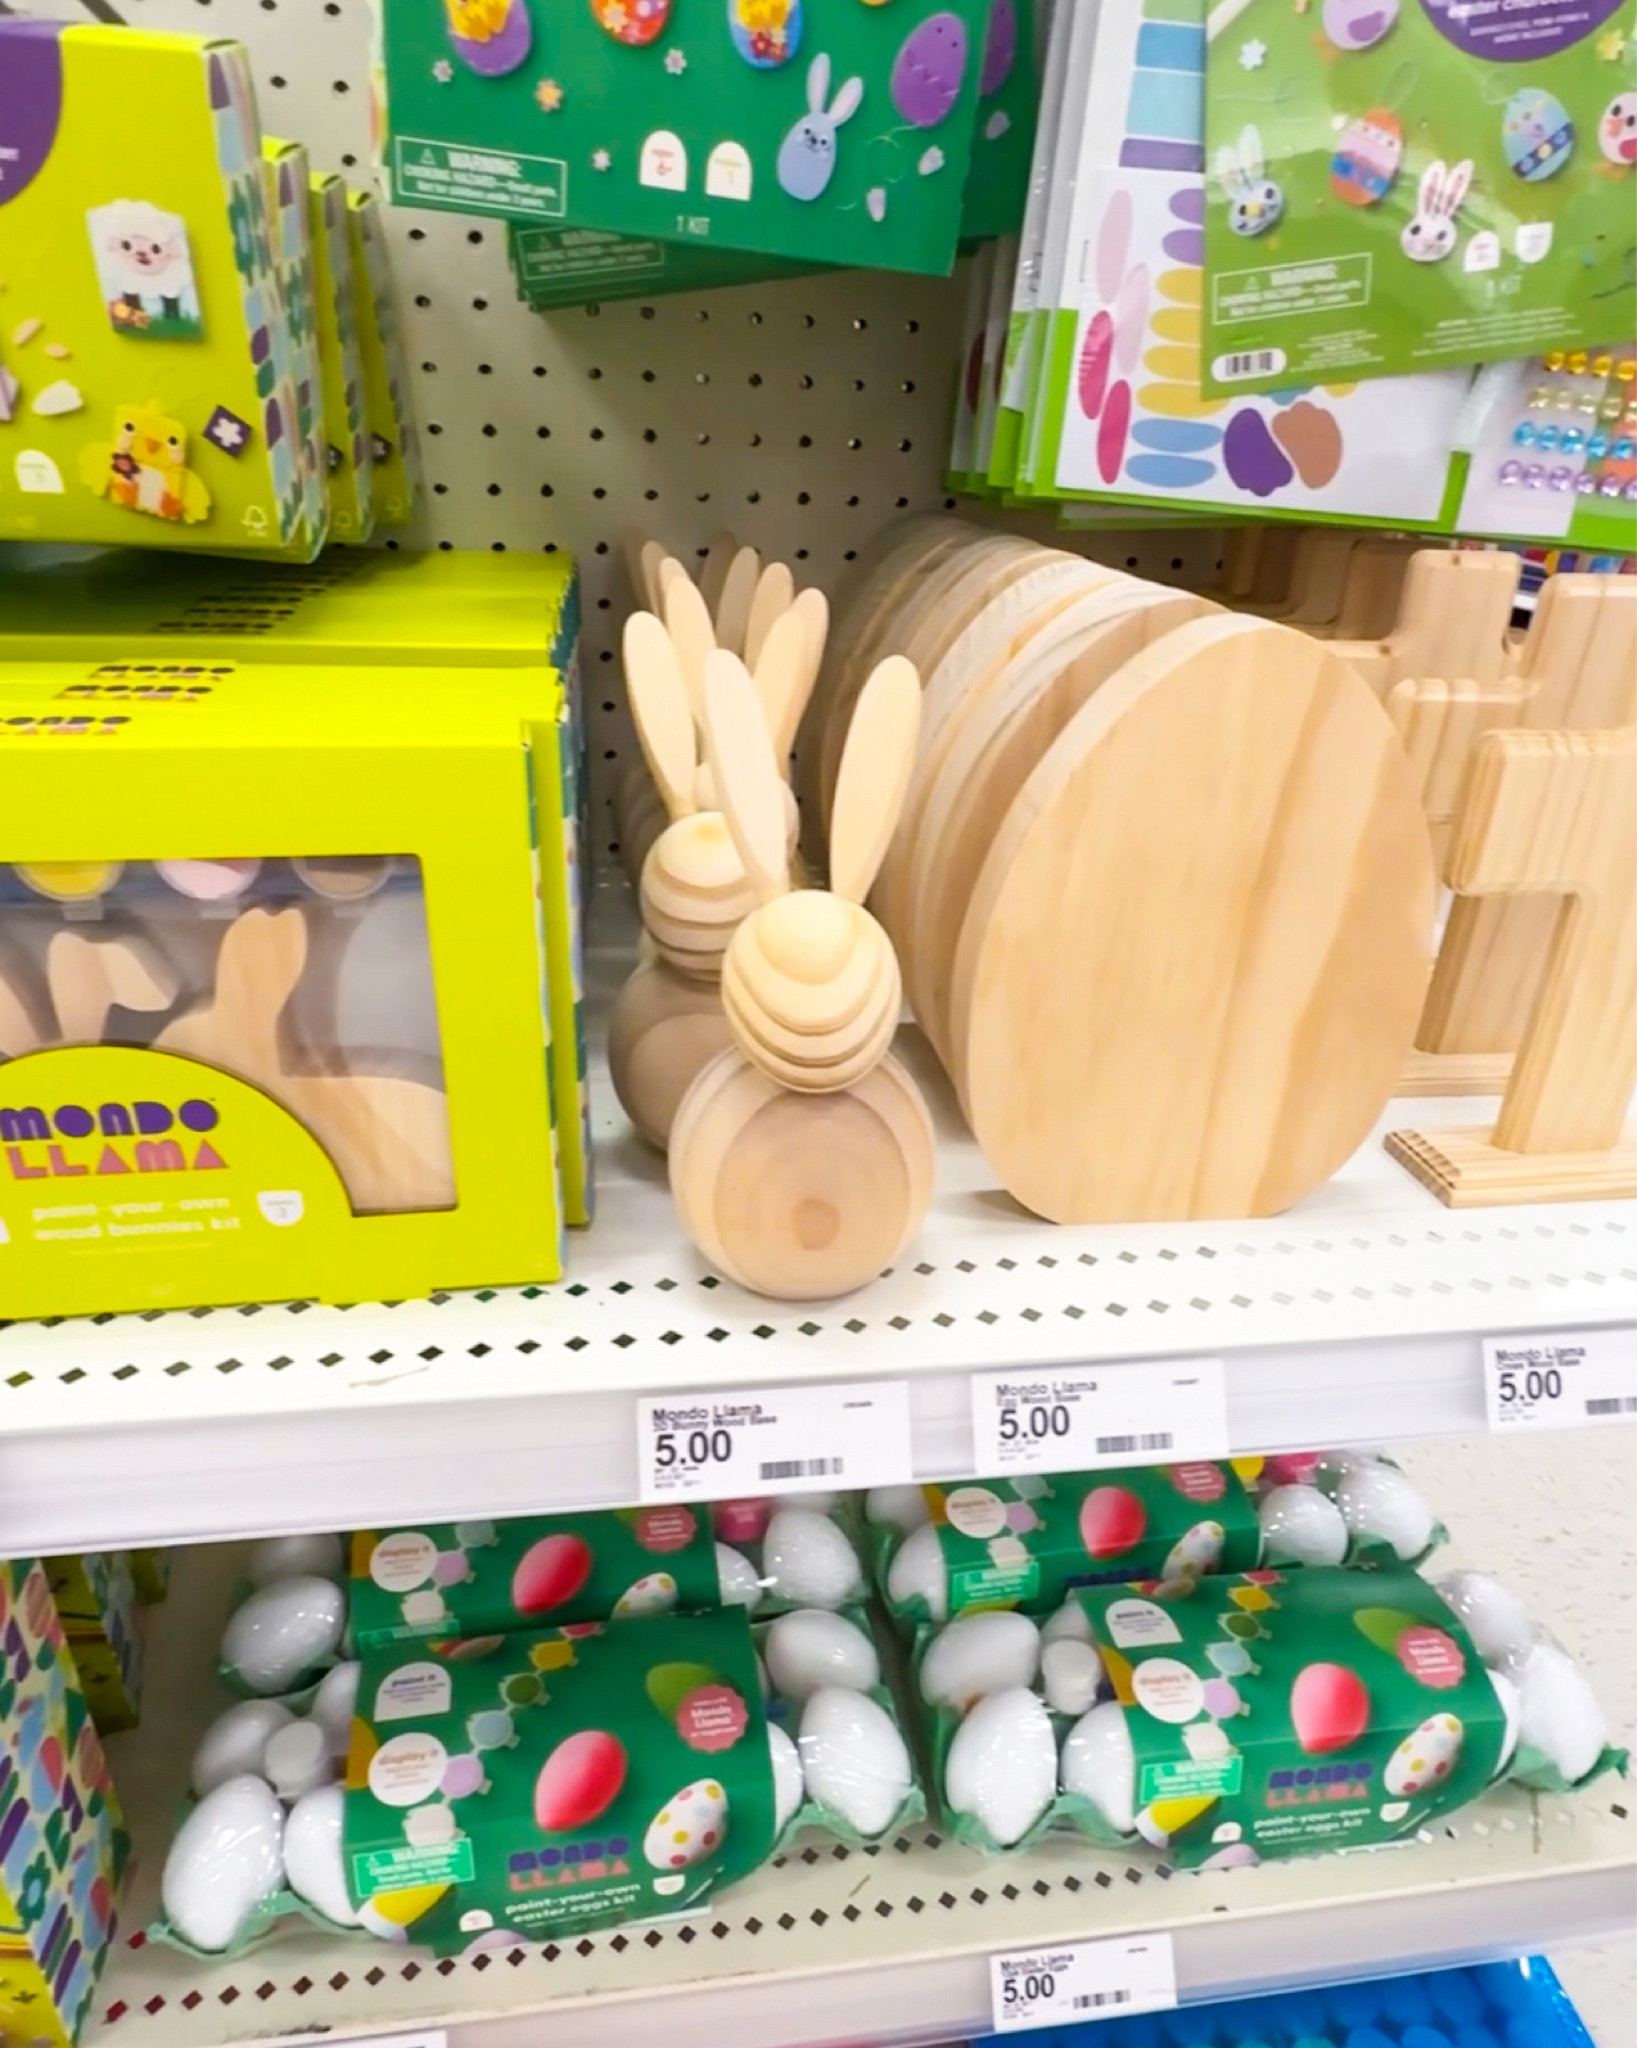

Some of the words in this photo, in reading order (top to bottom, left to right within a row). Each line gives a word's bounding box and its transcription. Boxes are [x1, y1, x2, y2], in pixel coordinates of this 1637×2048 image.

[5, 1138, 229, 1181] LLAMA
[1499, 1369, 1562, 1403] 5.00
[652, 1407, 709, 1421] Mondo
[713, 1404, 763, 1418] Llama
[1000, 1405, 1070, 1440] 5.00
[655, 1430, 732, 1467] 5.00
[613, 1894, 636, 1905] kit
[1004, 1973, 1056, 2004] 5.00
